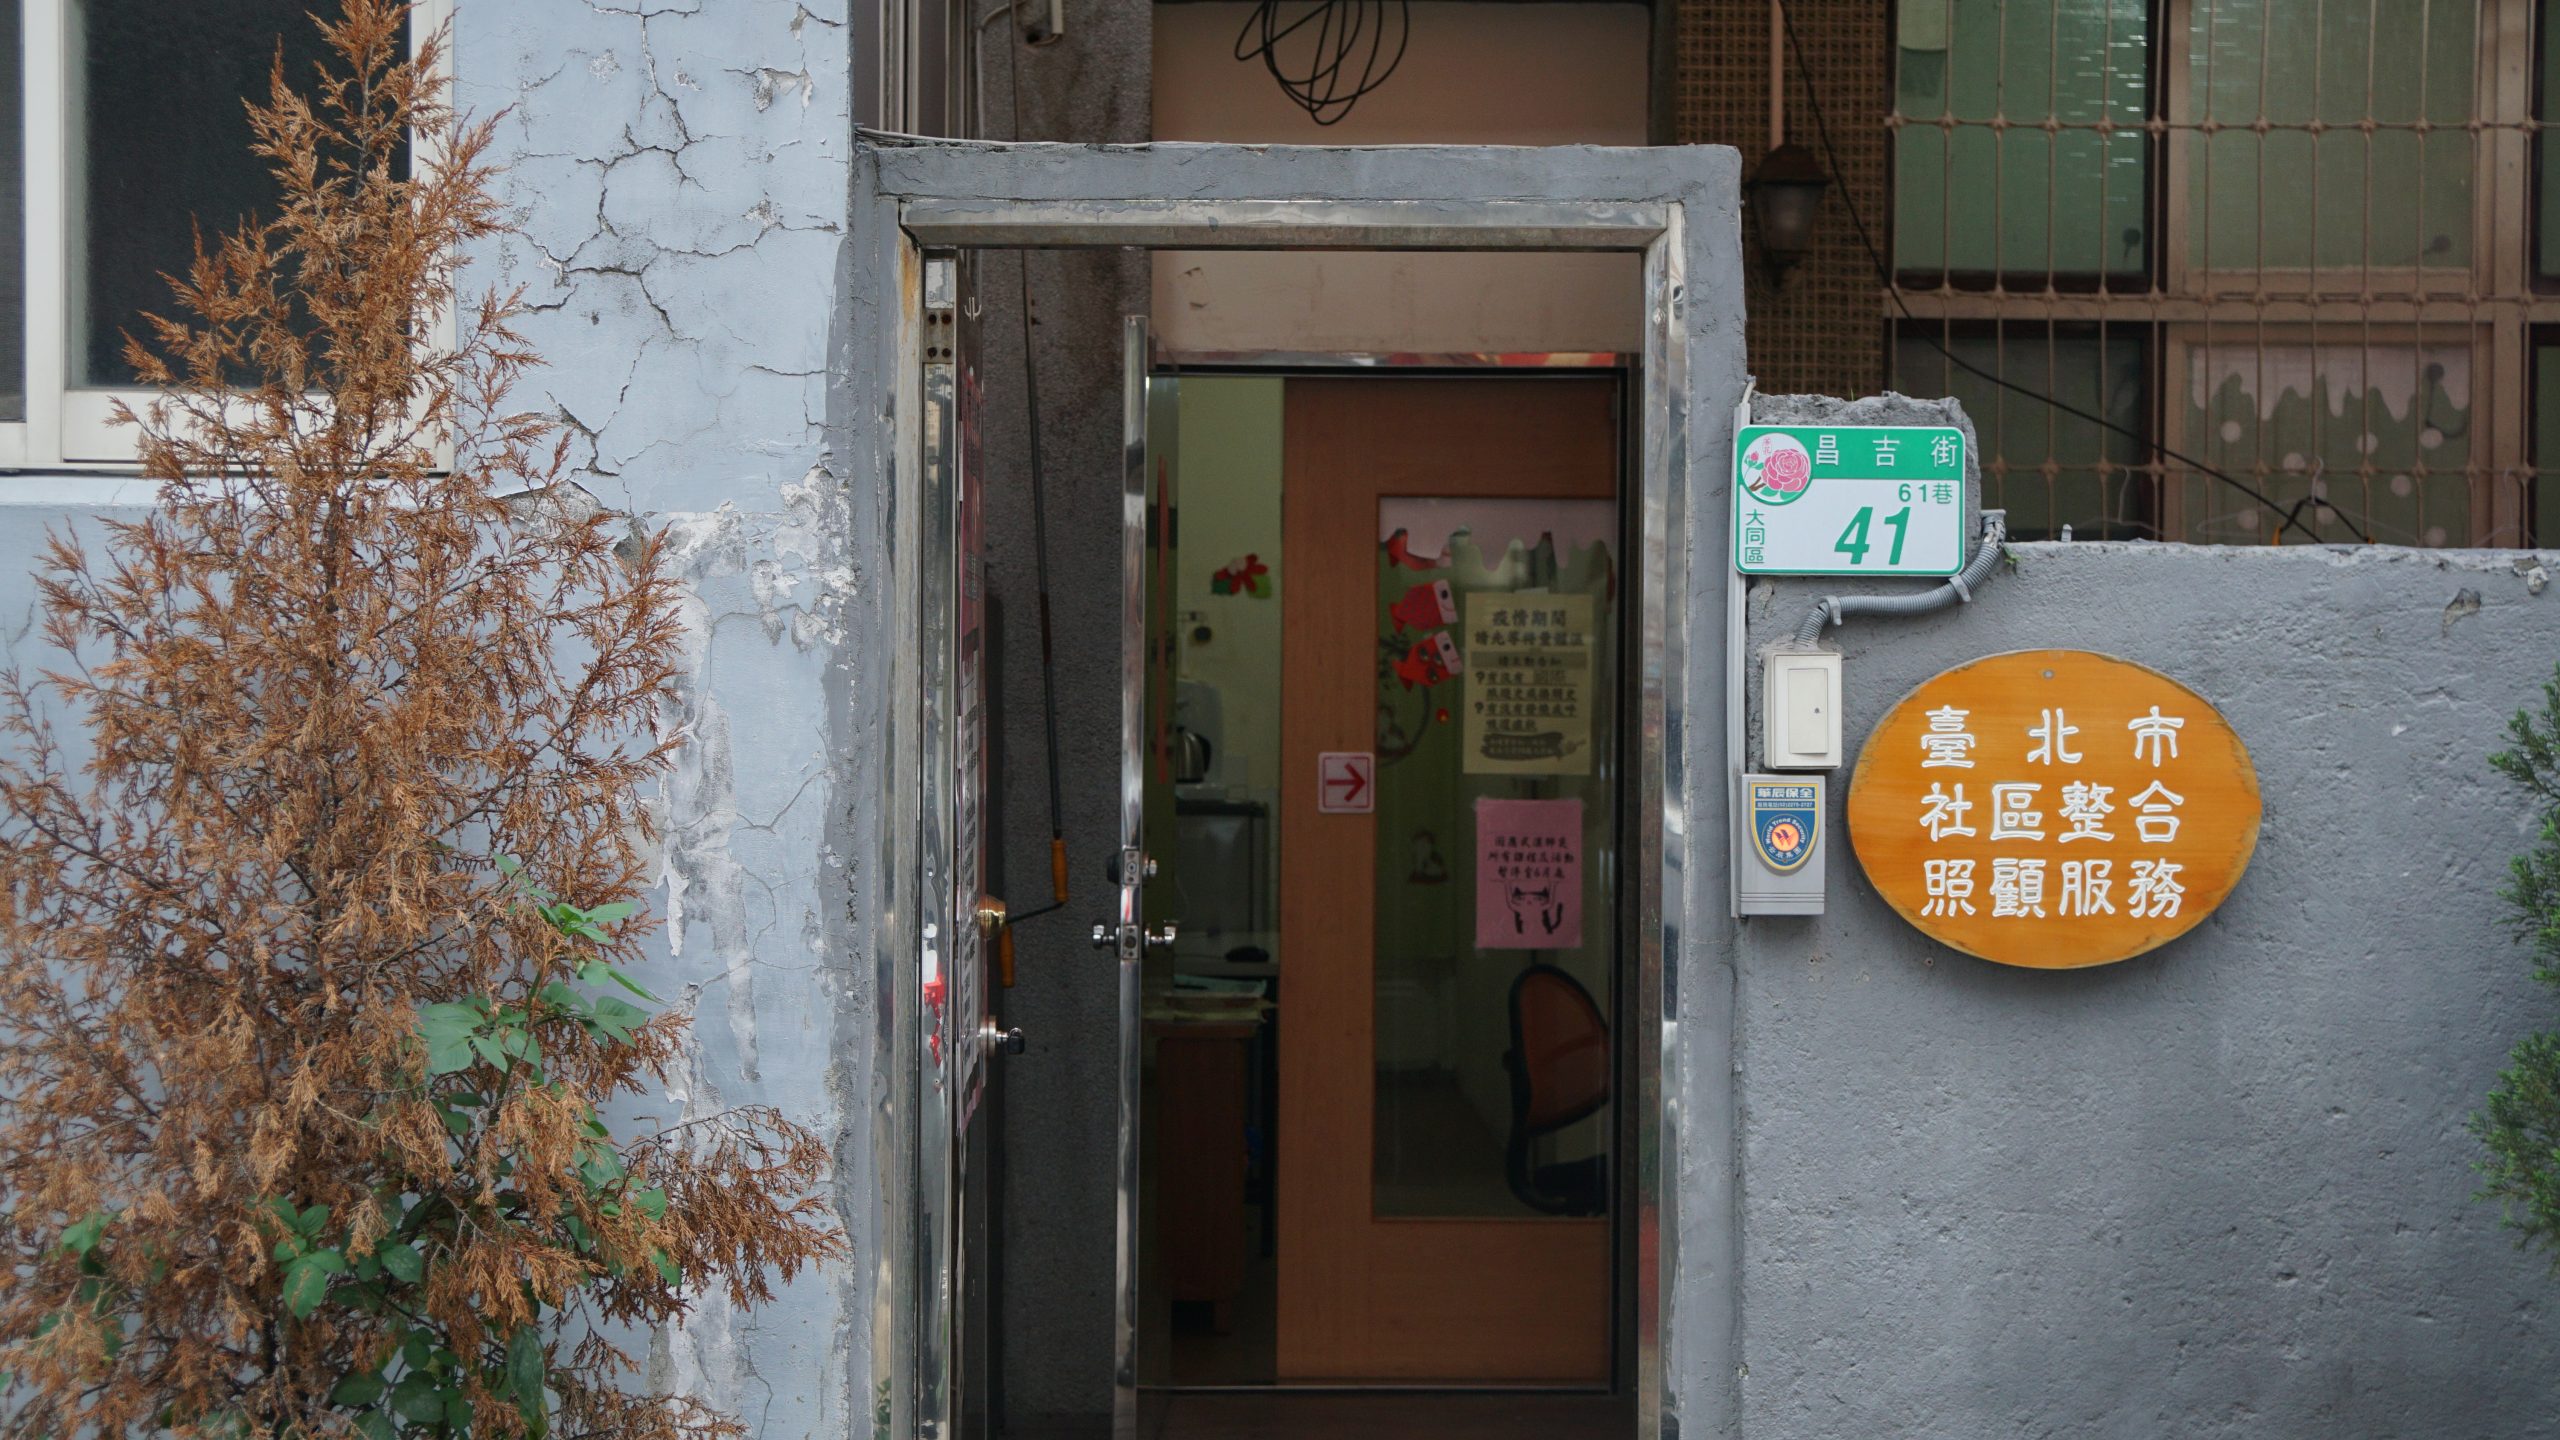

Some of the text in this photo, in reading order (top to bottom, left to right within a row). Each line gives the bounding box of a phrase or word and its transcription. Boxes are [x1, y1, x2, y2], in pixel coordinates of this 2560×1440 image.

[1815, 434, 1958, 468] 昌吉街
[1899, 483, 1953, 504] 61巷
[1744, 509, 1765, 564] 大同區
[1834, 506, 1911, 566] 41
[1492, 609, 1566, 627] 疫情期間
[1920, 705, 2185, 768] 臺北市
[1757, 787, 1814, 799] 華辰保全
[1919, 780, 2185, 843] 社區整合
[1766, 825, 1774, 845] World
[1772, 817, 1791, 826] Trend
[1920, 857, 2186, 919] 照顧服務
